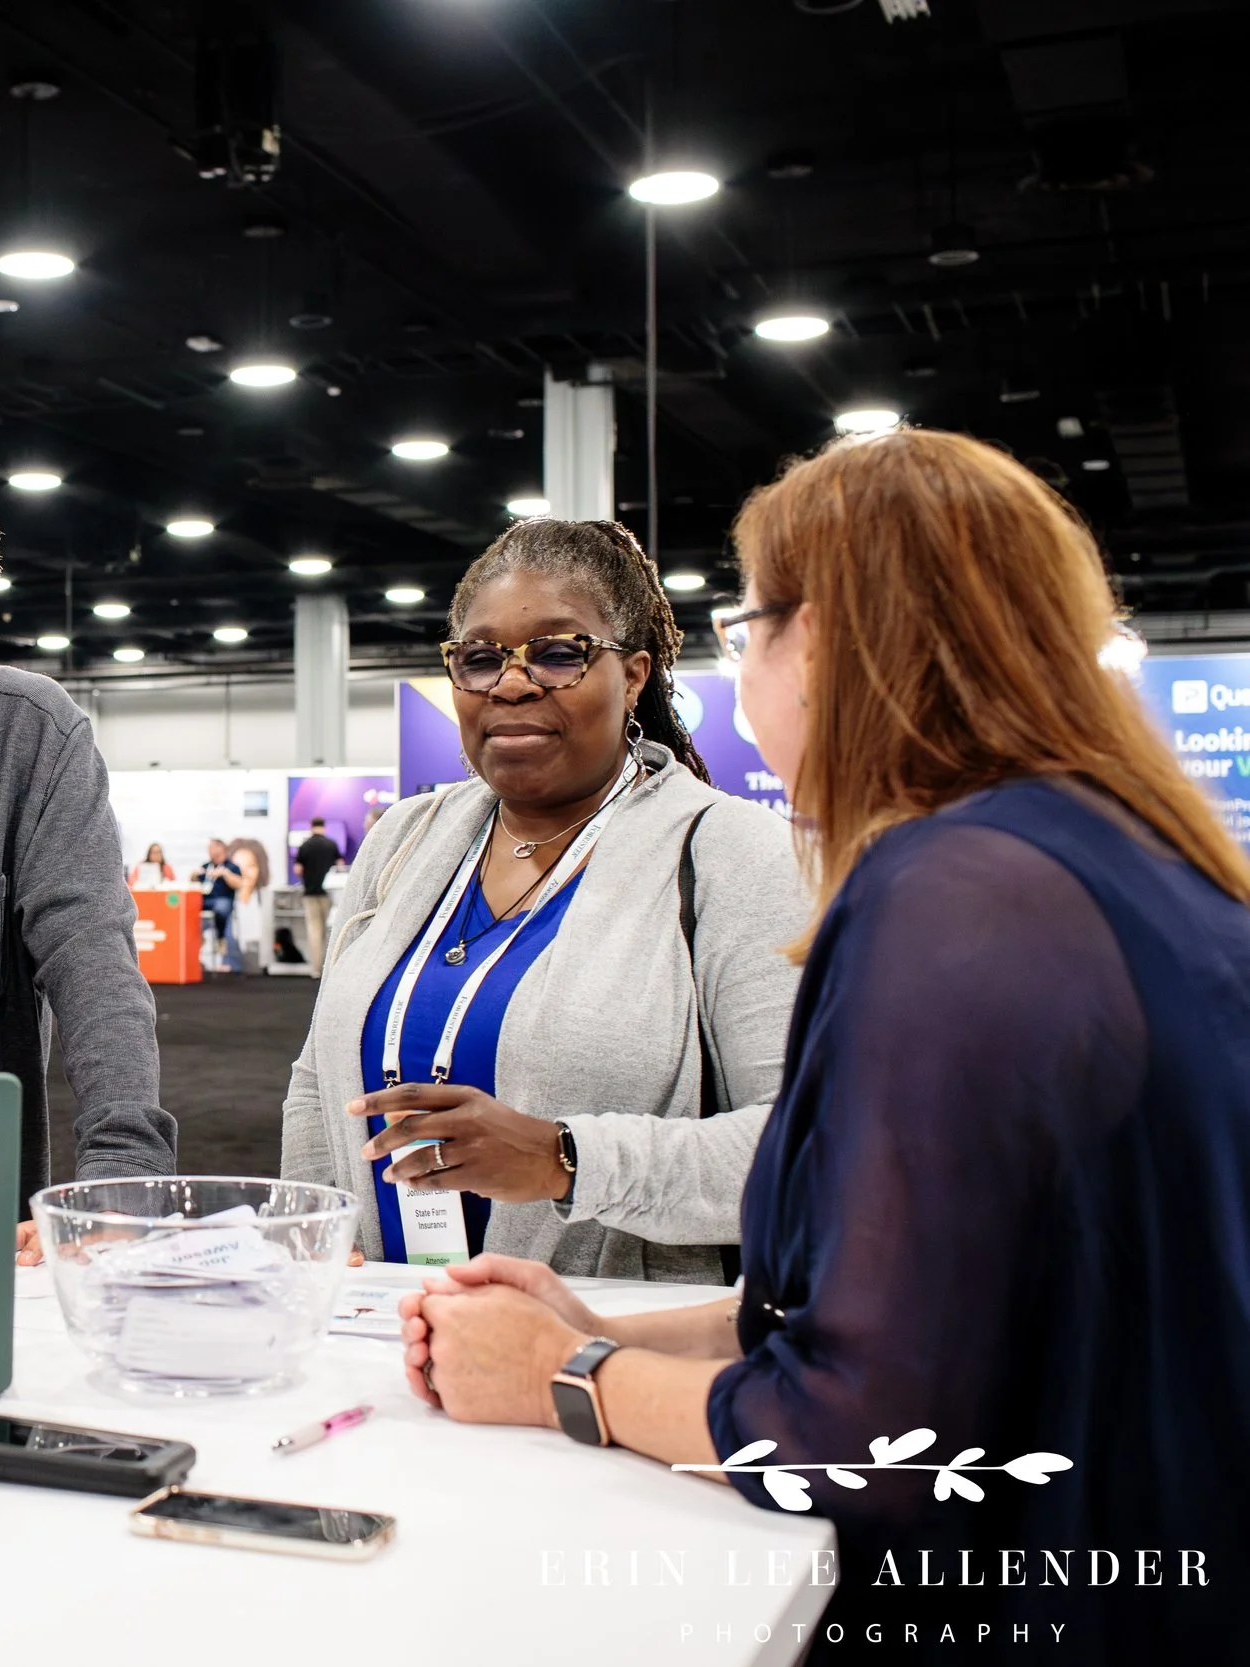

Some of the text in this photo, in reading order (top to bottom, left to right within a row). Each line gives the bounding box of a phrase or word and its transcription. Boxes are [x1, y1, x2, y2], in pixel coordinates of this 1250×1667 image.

[415, 1208, 448, 1218] State Farm
[418, 1221, 448, 1230] Insurance
